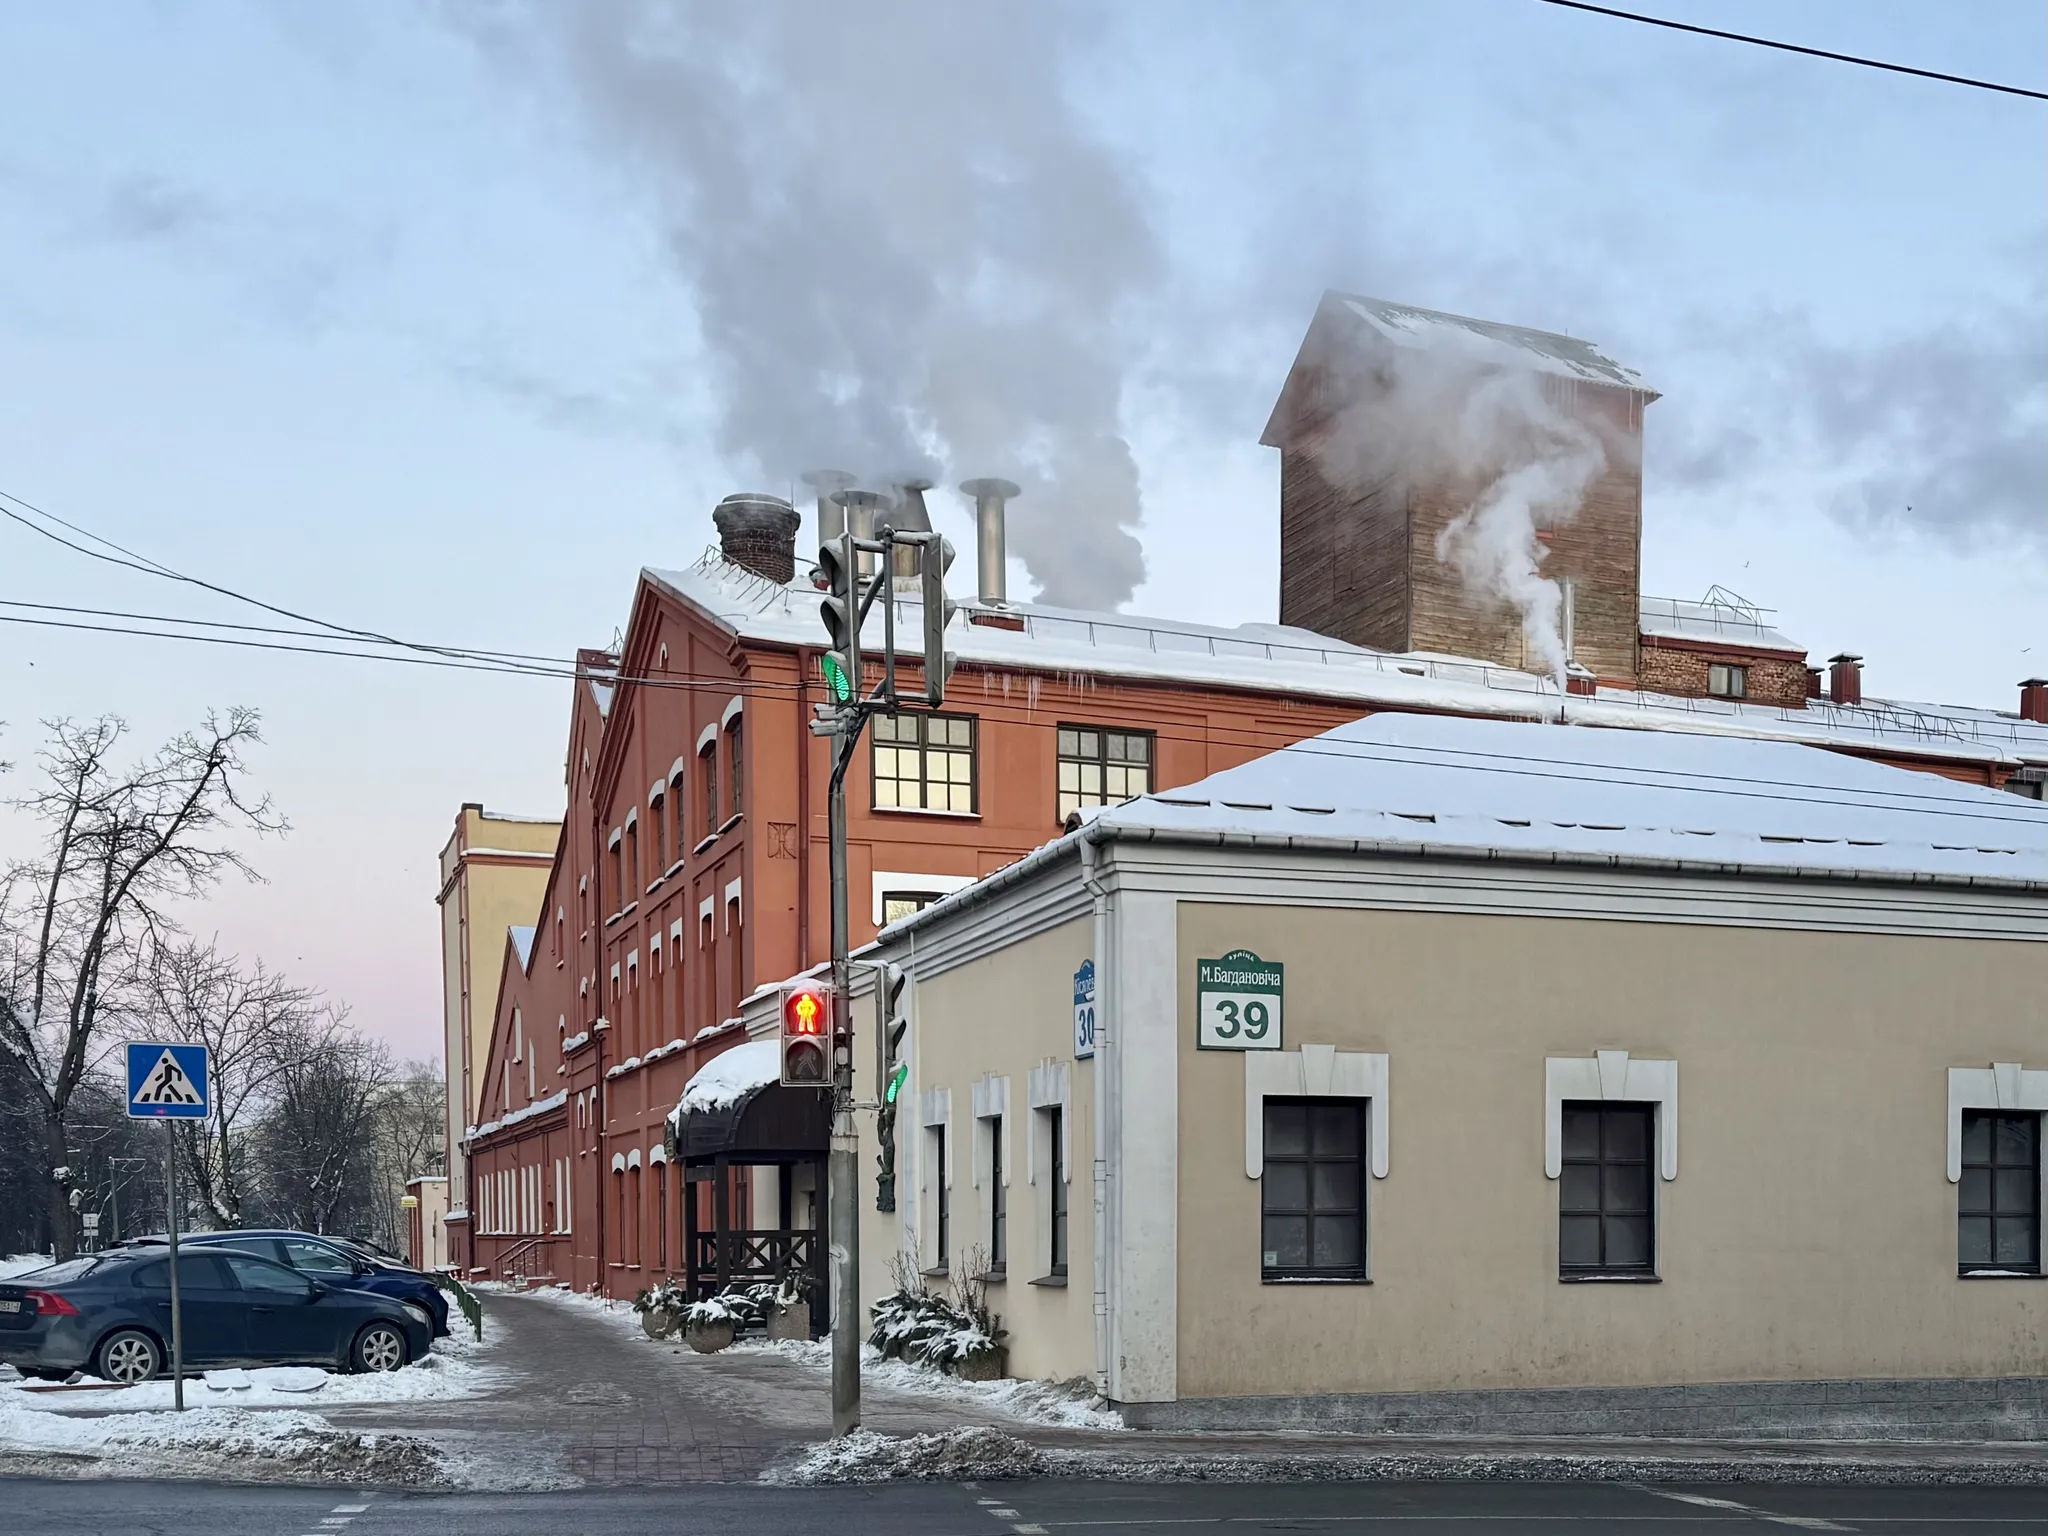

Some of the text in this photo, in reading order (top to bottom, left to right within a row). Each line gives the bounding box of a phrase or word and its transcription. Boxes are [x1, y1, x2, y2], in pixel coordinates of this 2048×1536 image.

[1201, 966, 1281, 987] М.Багдановіча
[1079, 1007, 1095, 1046] 30
[1215, 1000, 1269, 1040] 39
